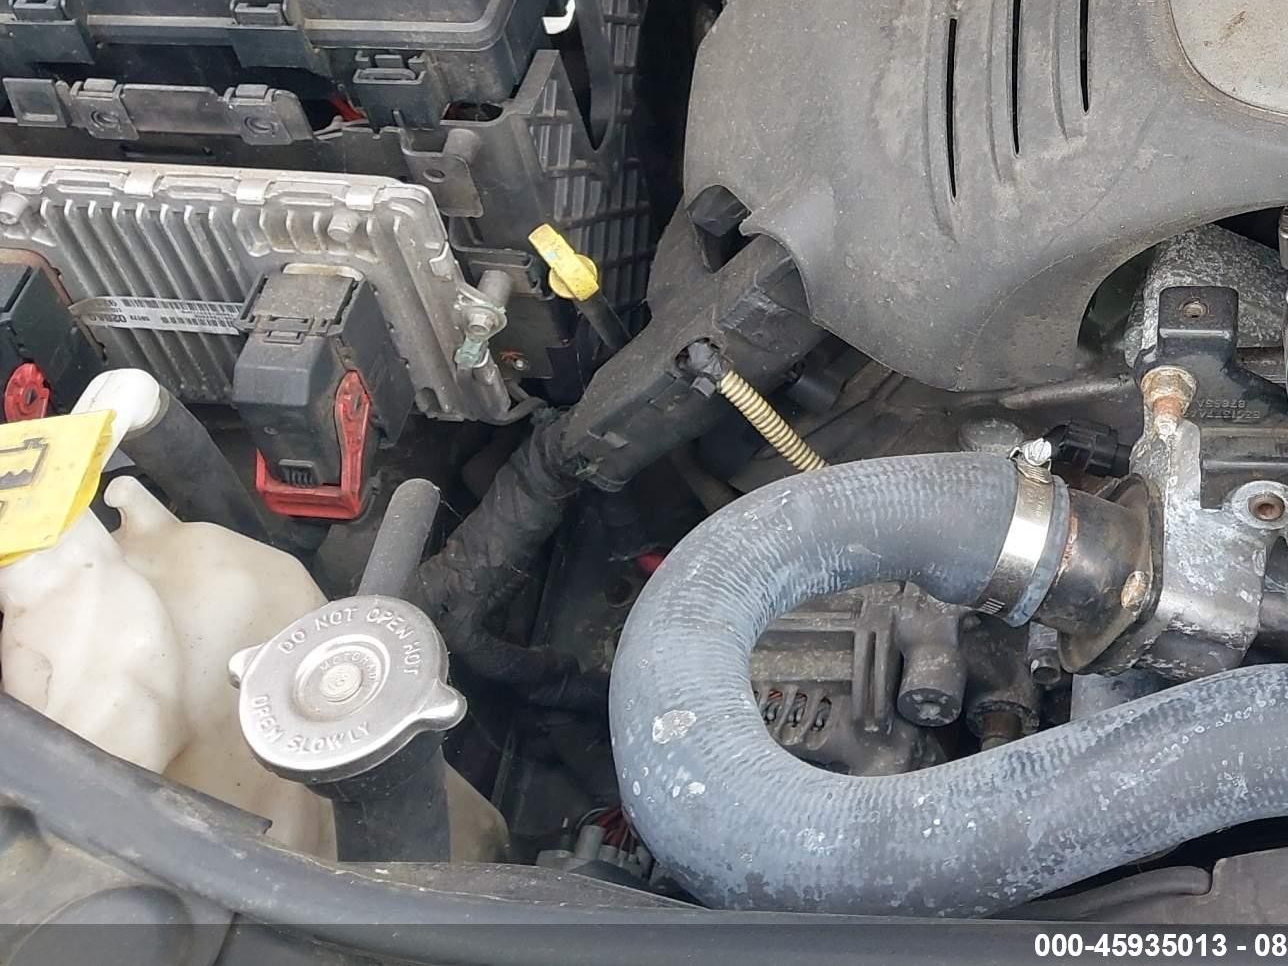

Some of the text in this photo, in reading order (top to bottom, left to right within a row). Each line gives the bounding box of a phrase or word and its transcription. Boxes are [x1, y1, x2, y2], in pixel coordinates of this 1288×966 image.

[277, 607, 423, 675] DO NOT OPEN HOT
[251, 693, 371, 754] OPEN SLOWLY
